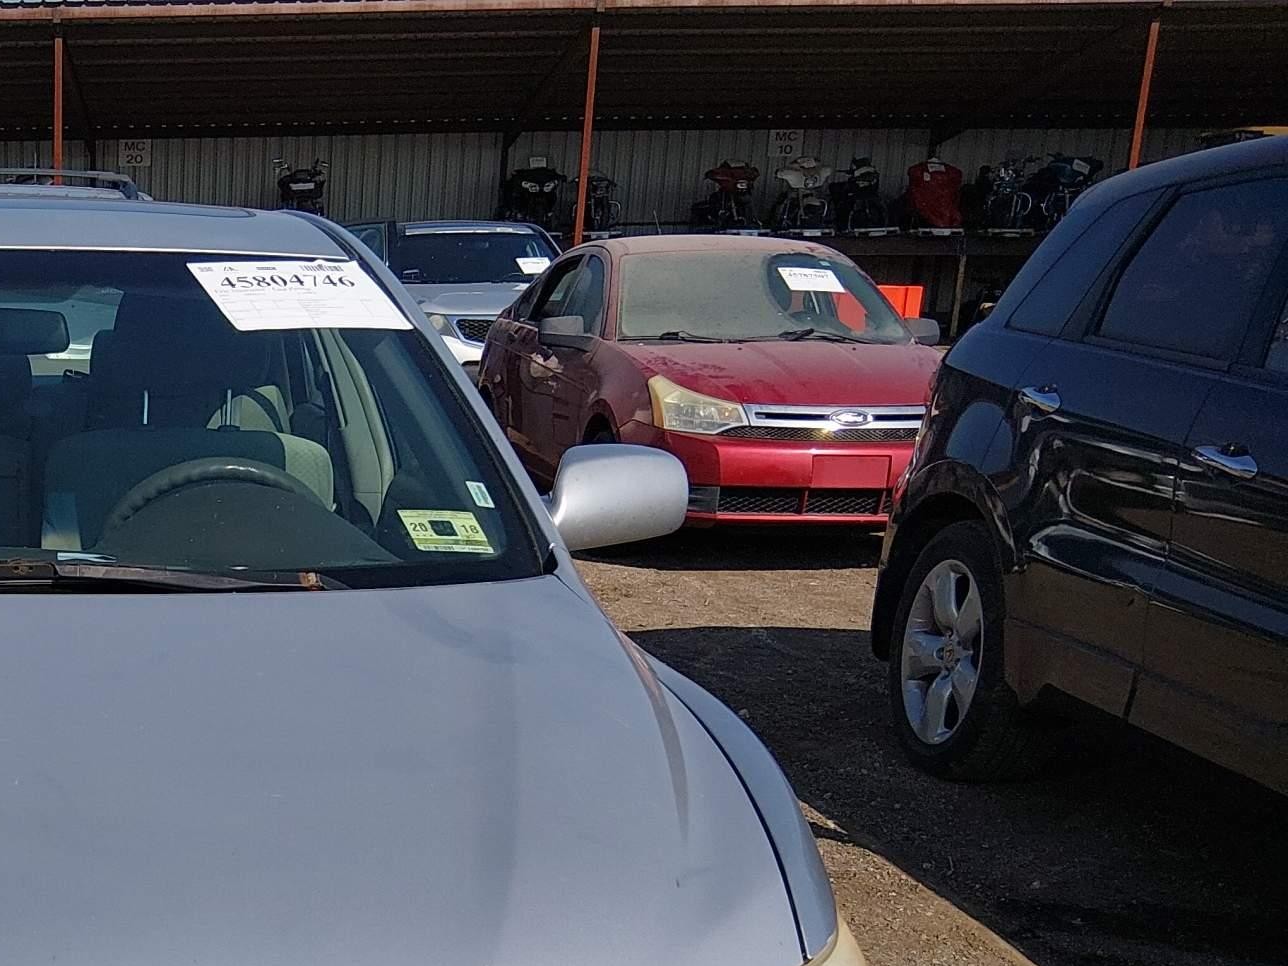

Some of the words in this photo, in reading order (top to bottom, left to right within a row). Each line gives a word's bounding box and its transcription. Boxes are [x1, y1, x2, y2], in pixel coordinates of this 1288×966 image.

[775, 131, 798, 141] MC
[124, 141, 146, 151] MC
[778, 144, 793, 155] 10
[126, 153, 143, 164] 20
[220, 273, 356, 289] 45804746
[410, 522, 428, 533] 20
